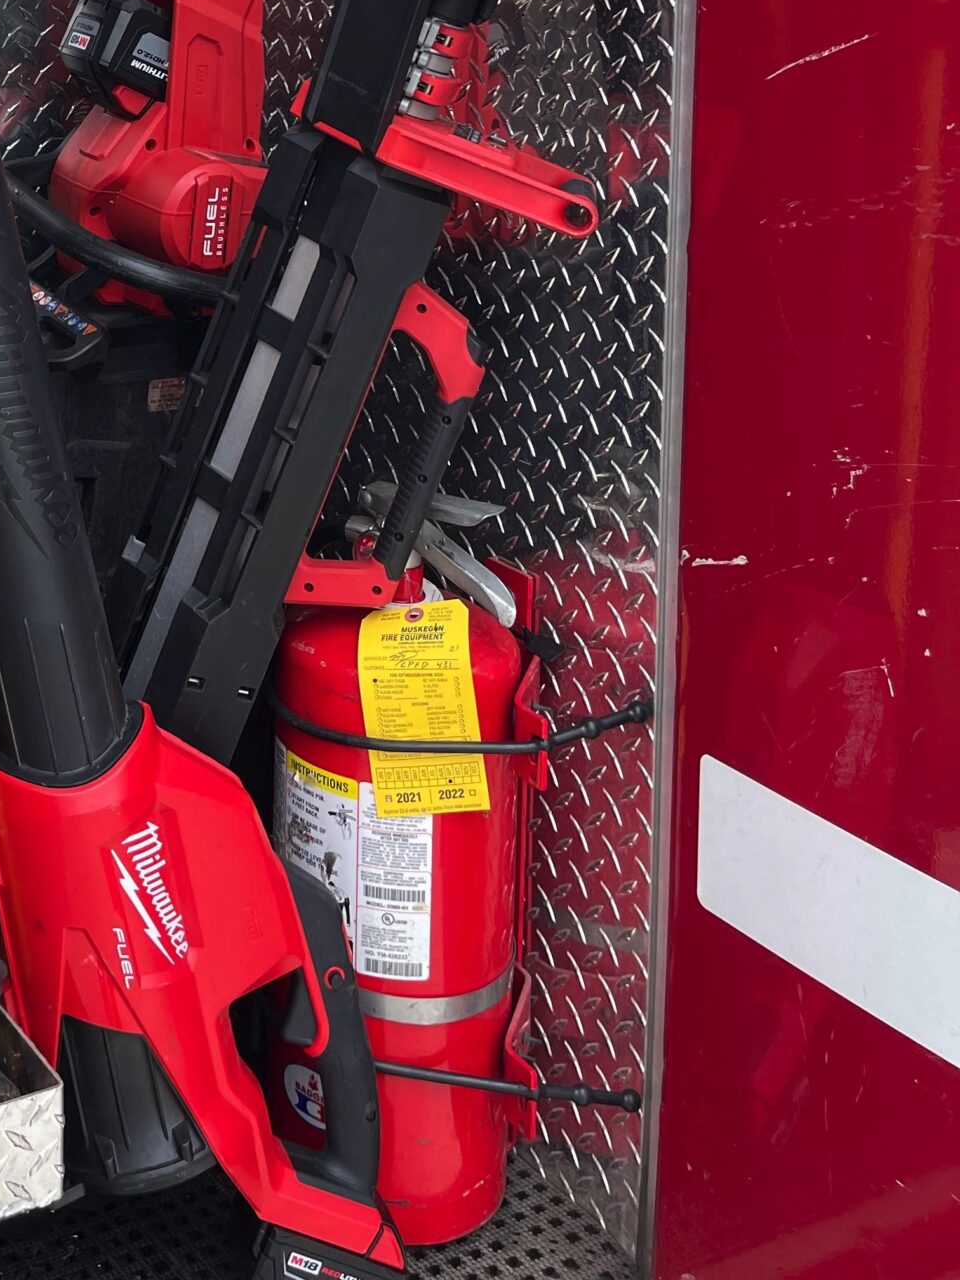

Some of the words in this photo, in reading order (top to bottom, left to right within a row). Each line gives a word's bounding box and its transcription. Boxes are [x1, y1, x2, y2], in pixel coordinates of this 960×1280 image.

[70, 34, 89, 47] M18
[203, 187, 219, 256] FUEL
[216, 187, 229, 256] BRUSHLESS
[401, 623, 444, 633] MUSKEGON
[381, 634, 398, 642] FIRE
[400, 632, 444, 641] EQUIPMENT
[396, 792, 422, 804] 2021
[438, 788, 464, 800] 2022
[305, 800, 320, 812] FROM
[121, 821, 188, 959] Milwaukee
[112, 927, 135, 989] FUEL
[295, 1081, 325, 1105] BADGE
[290, 1255, 319, 1271] M18
